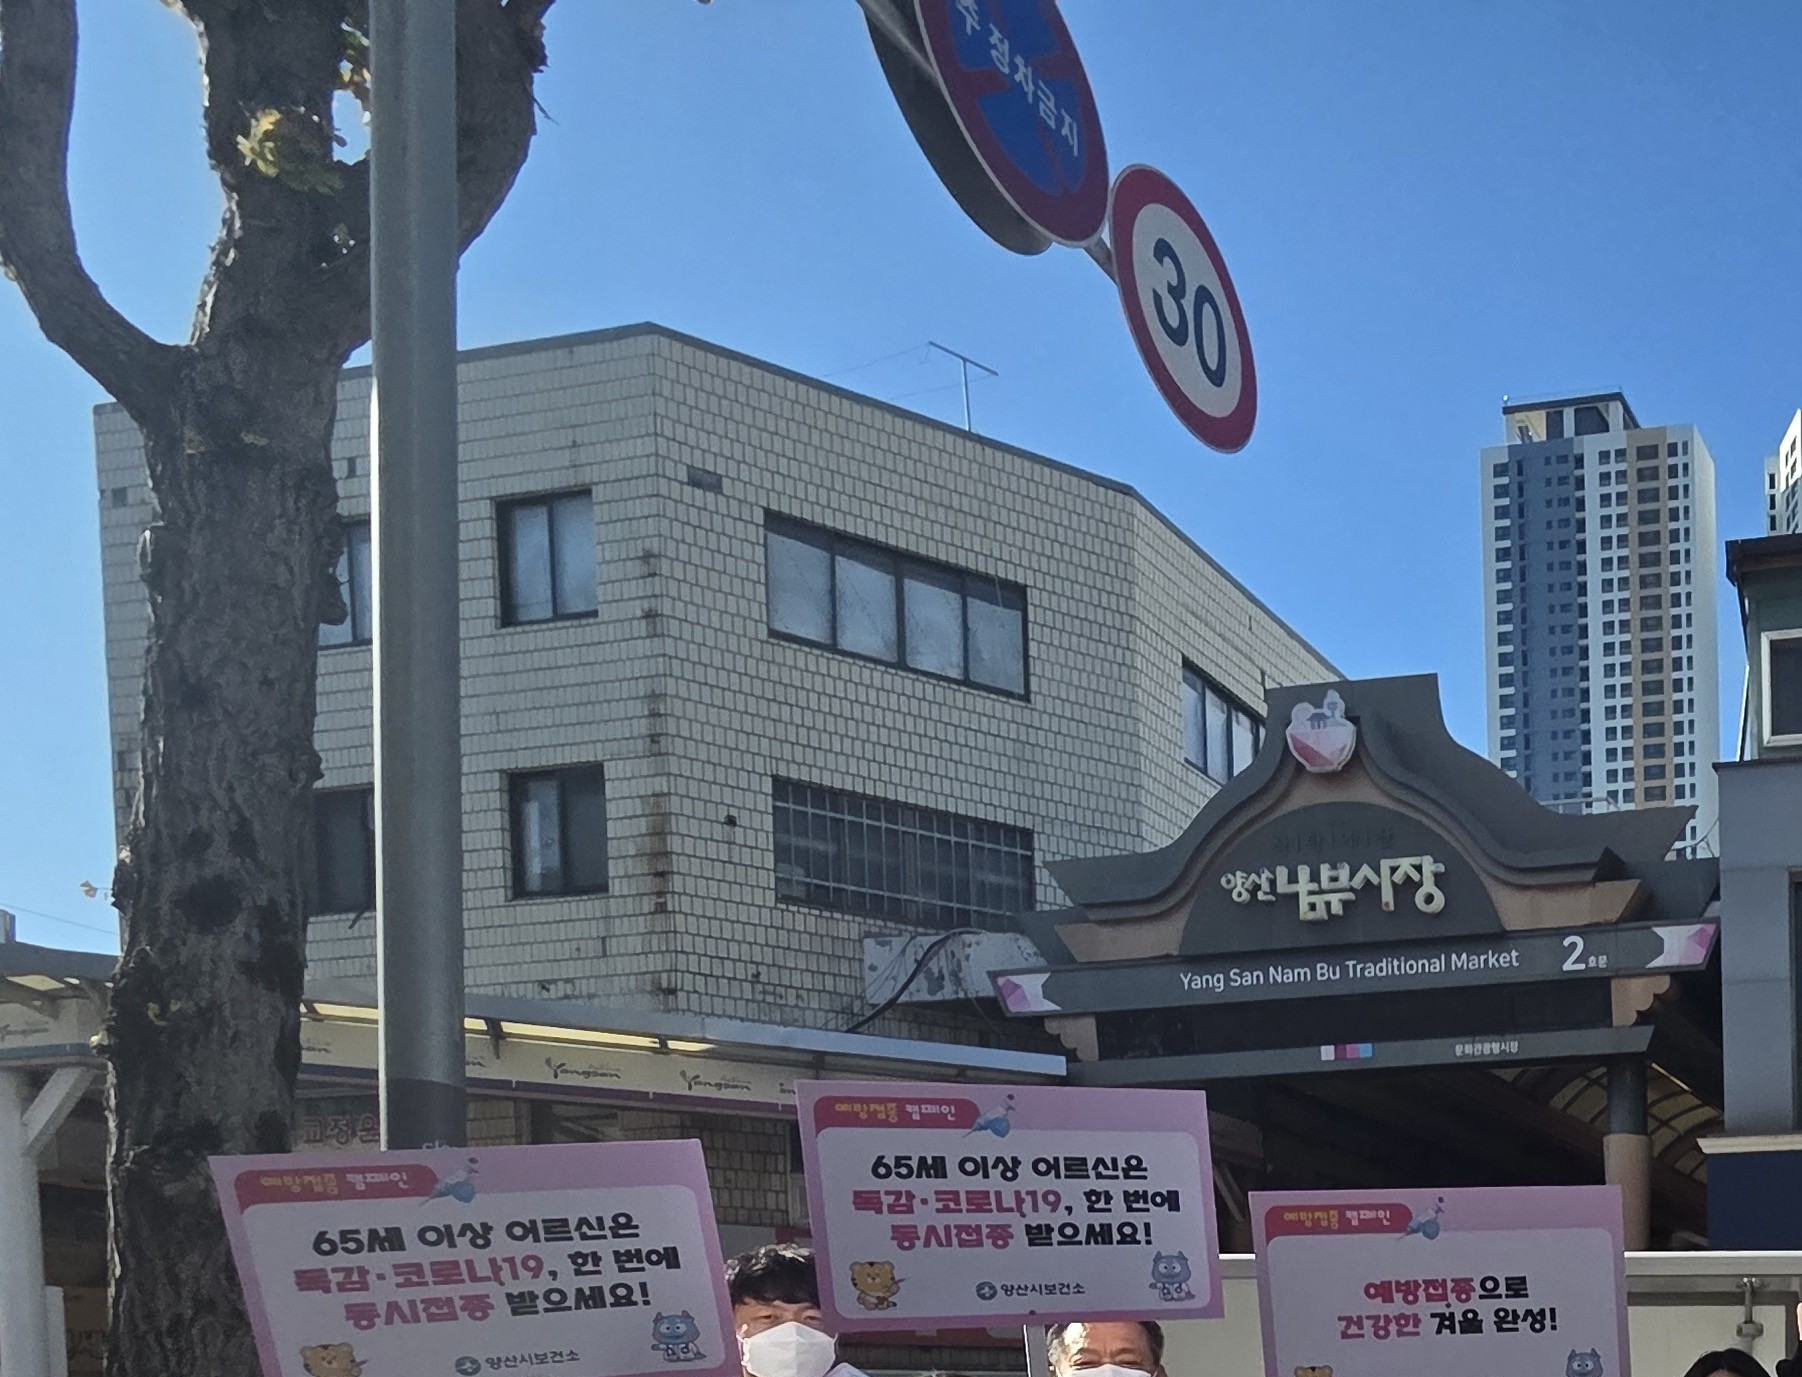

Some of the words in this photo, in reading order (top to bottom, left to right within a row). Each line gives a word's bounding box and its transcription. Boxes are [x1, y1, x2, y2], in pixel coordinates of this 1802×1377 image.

[1153, 238, 1226, 388] 30
[1220, 868, 1276, 904] 양산
[1276, 855, 1445, 921] 남부시장
[1180, 972, 1224, 993] Yang
[1229, 968, 1264, 986] San
[1269, 965, 1311, 984] Nam
[1317, 963, 1340, 981] Bu
[1345, 955, 1446, 980] Traditional
[1451, 949, 1519, 972] Market
[835, 1102, 898, 1123] 예방접종
[905, 1103, 956, 1121] 캠페인
[870, 1155, 948, 1180] 65세
[958, 1155, 1021, 1182] 이상
[1031, 1154, 1149, 1181] 어르신은
[260, 1171, 339, 1196] 예방접종
[345, 1169, 409, 1191] 캠페인
[1083, 1188, 1112, 1214] 한
[1123, 1188, 1181, 1214] 번에
[1283, 1209, 1339, 1229] 예방접종
[1345, 1209, 1391, 1226] 캠페인
[312, 1226, 406, 1257] 65세
[417, 1221, 493, 1250] 이상
[506, 1212, 640, 1243] 어르신은
[890, 1223, 1014, 1250] 동시접종
[1025, 1222, 1153, 1248] 받으세요!
[567, 1249, 603, 1279] 한
[613, 1245, 681, 1274] 번에
[1001, 1280, 1086, 1298] 양산시보건소
[1364, 1276, 1529, 1305] 예방접종으로
[344, 1294, 494, 1331] 동시접종
[505, 1283, 651, 1317] 받으세요!
[1338, 1312, 1421, 1340] 건강한
[1430, 1309, 1484, 1335] 겨울
[1493, 1307, 1558, 1334] 완성!
[485, 1349, 580, 1372] 양산시보건소
